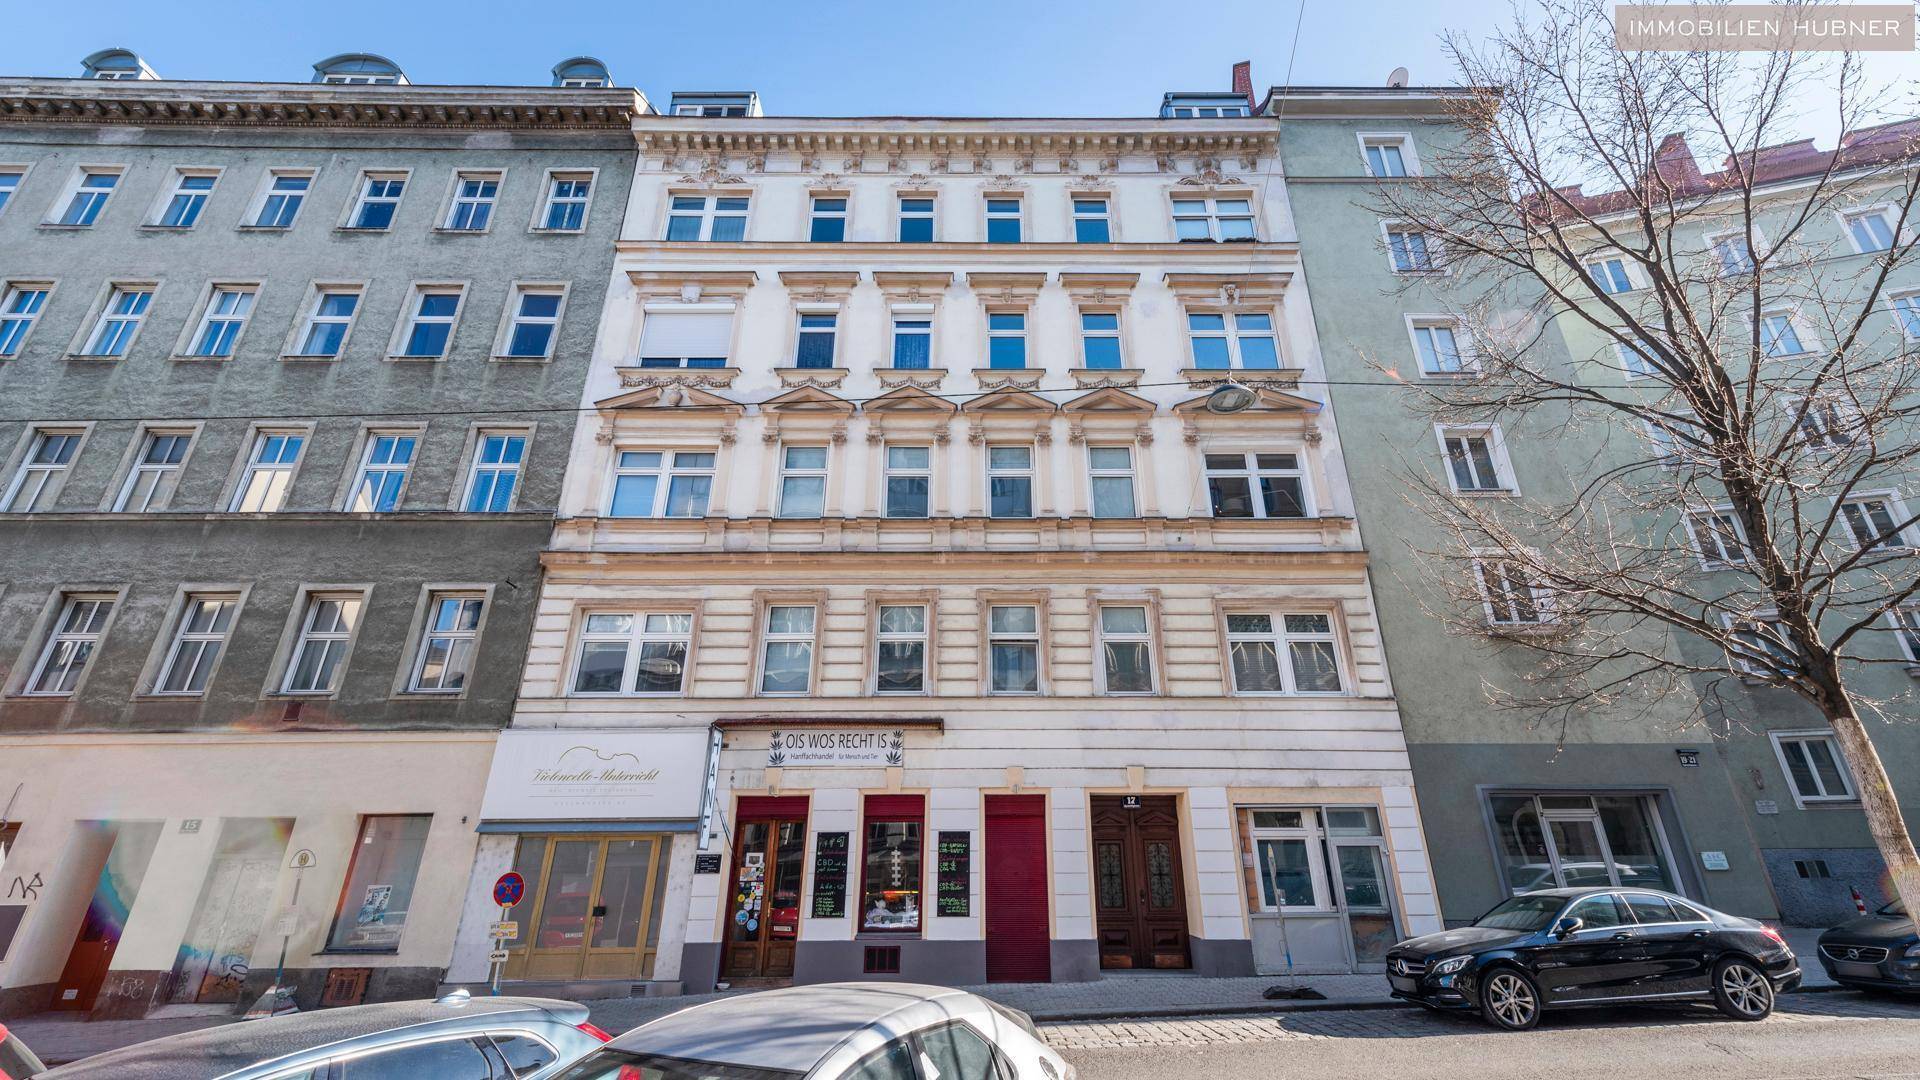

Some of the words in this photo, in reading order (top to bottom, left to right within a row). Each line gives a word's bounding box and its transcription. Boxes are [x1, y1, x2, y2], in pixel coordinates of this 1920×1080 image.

[785, 733, 806, 749] OIS
[808, 733, 835, 749] WOS
[838, 733, 875, 749] RECHT
[877, 733, 887, 749] IS
[790, 752, 835, 760] Hanffachhandel
